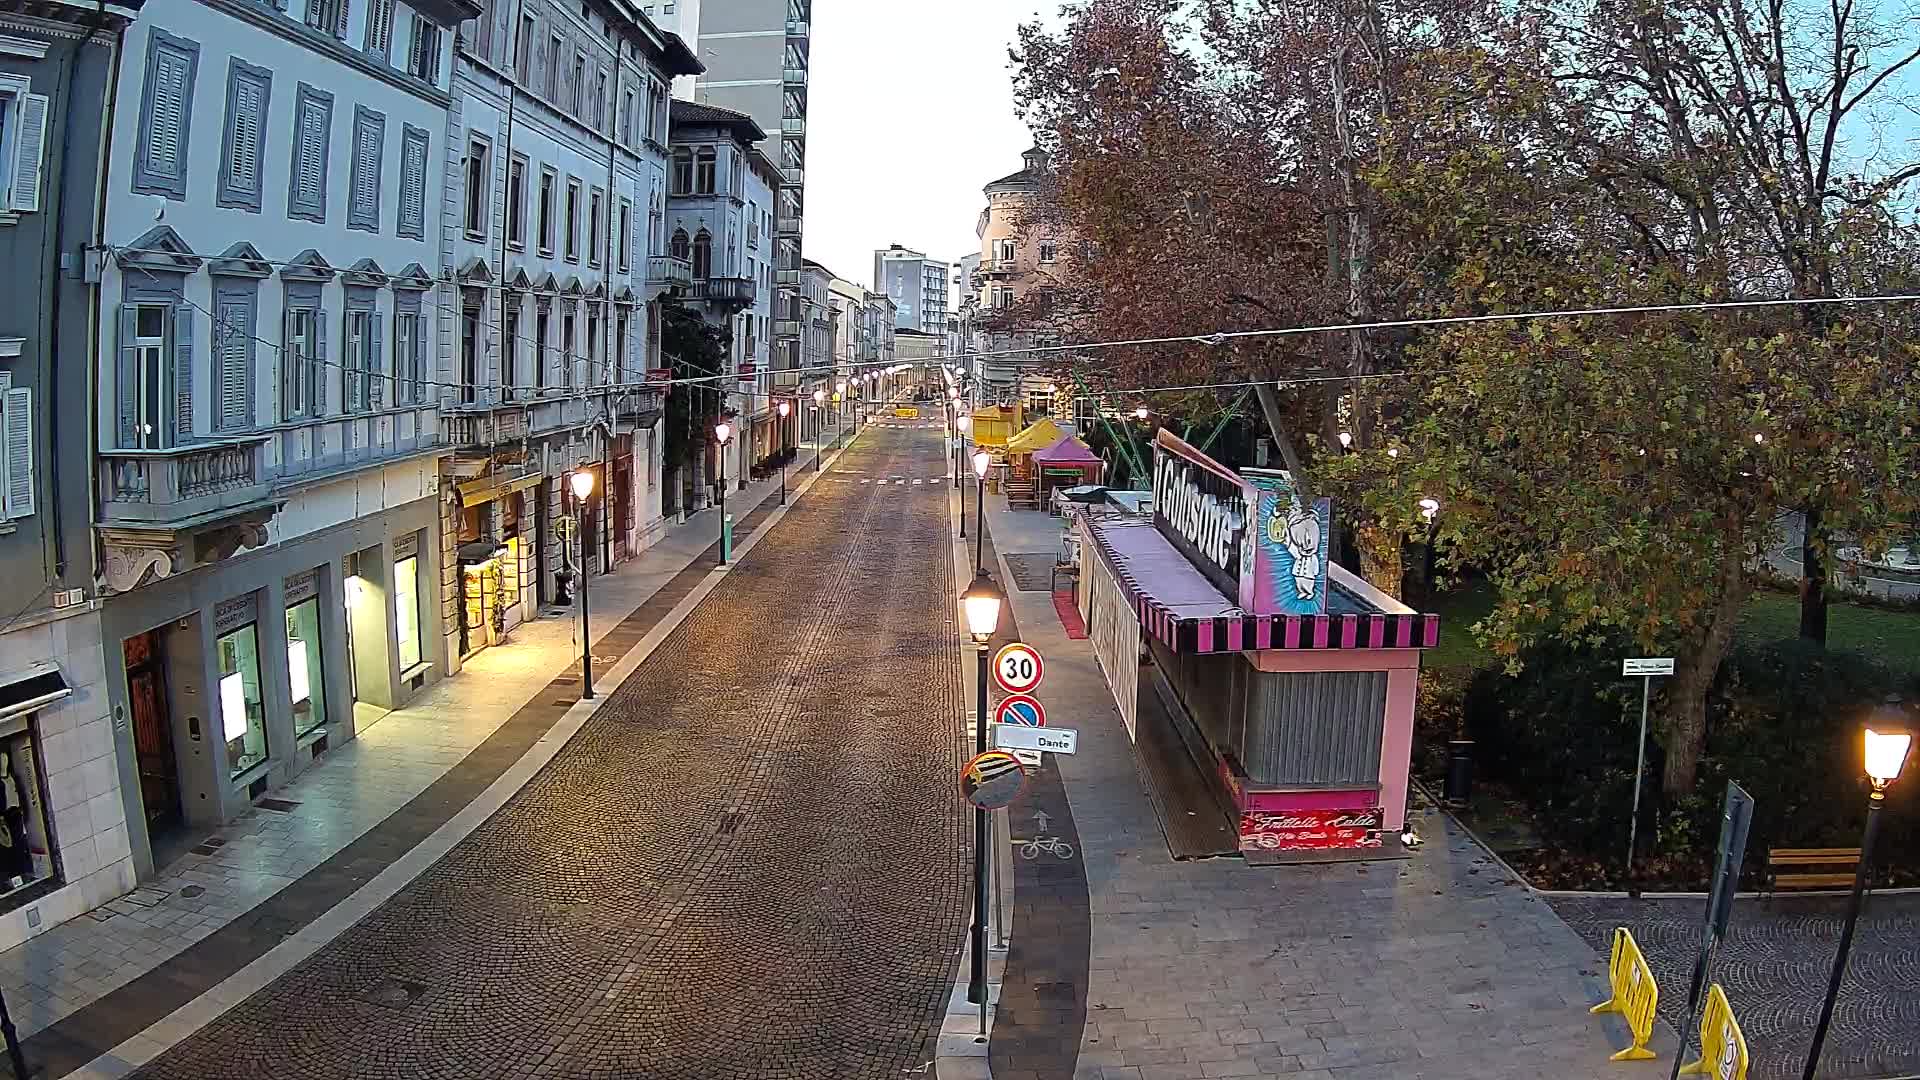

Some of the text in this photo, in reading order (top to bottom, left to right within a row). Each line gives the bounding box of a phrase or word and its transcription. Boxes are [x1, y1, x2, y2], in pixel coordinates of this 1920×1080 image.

[1162, 458, 1233, 570] Golosone
[1005, 657, 1033, 680] 30
[1038, 736, 1070, 749] Dante
